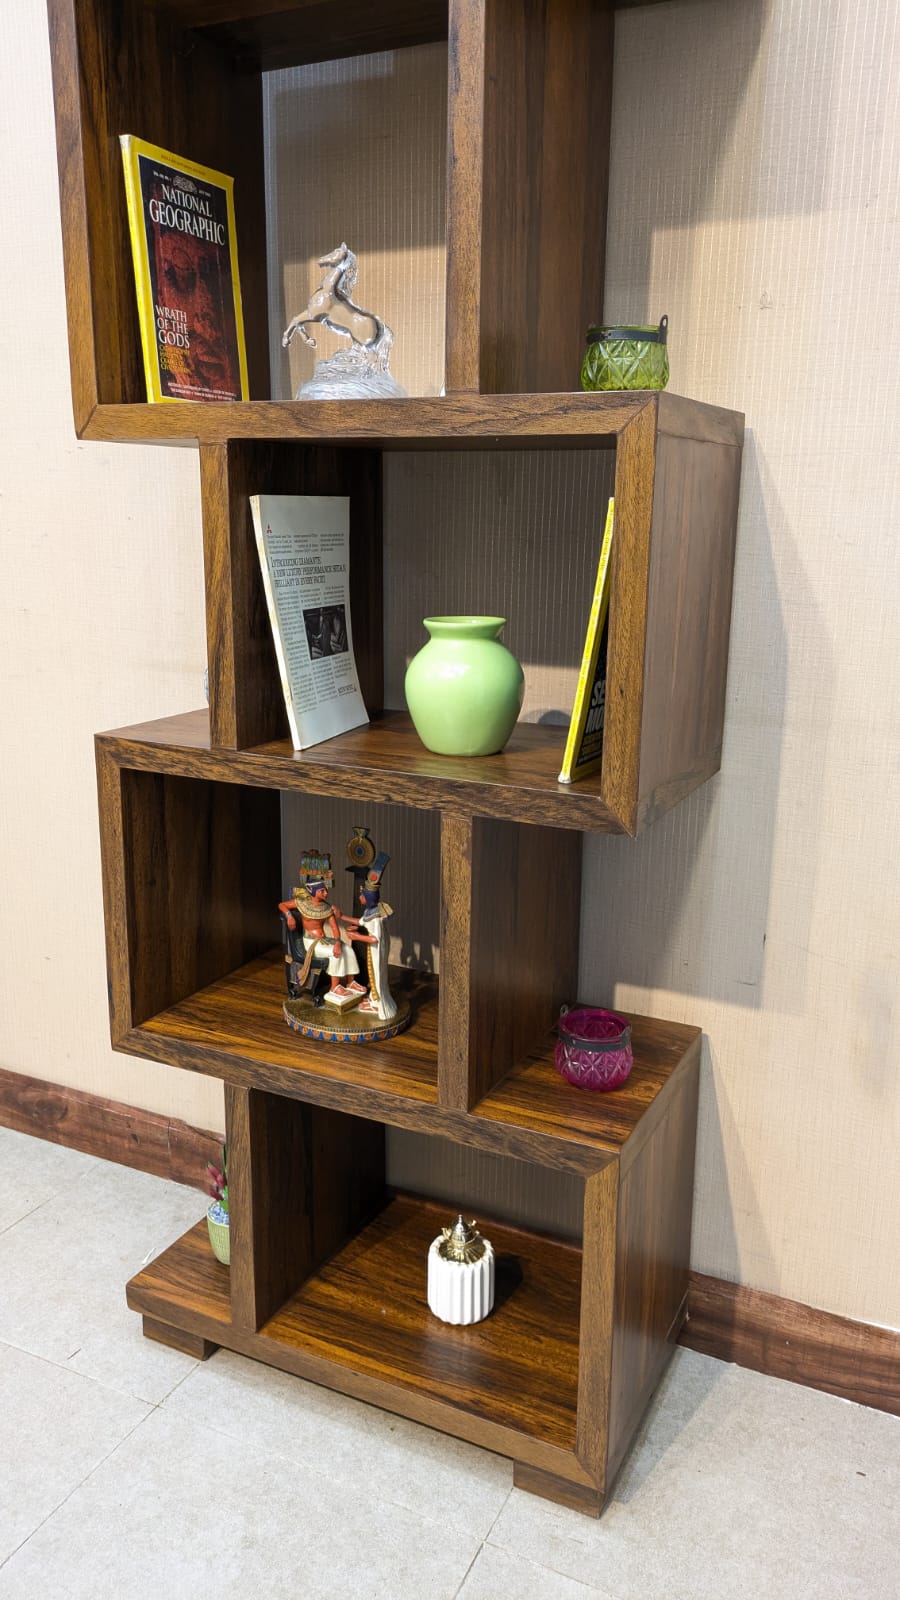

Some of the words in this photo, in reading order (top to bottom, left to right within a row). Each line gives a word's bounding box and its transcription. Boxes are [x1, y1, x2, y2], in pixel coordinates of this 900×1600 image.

[161, 183, 213, 218] NATIONAL
[149, 199, 225, 246] GEOGRAPHIC
[155, 304, 187, 323] WRATH
[157, 317, 169, 330] OF
[170, 320, 189, 335] THE
[158, 329, 190, 349] GODS
